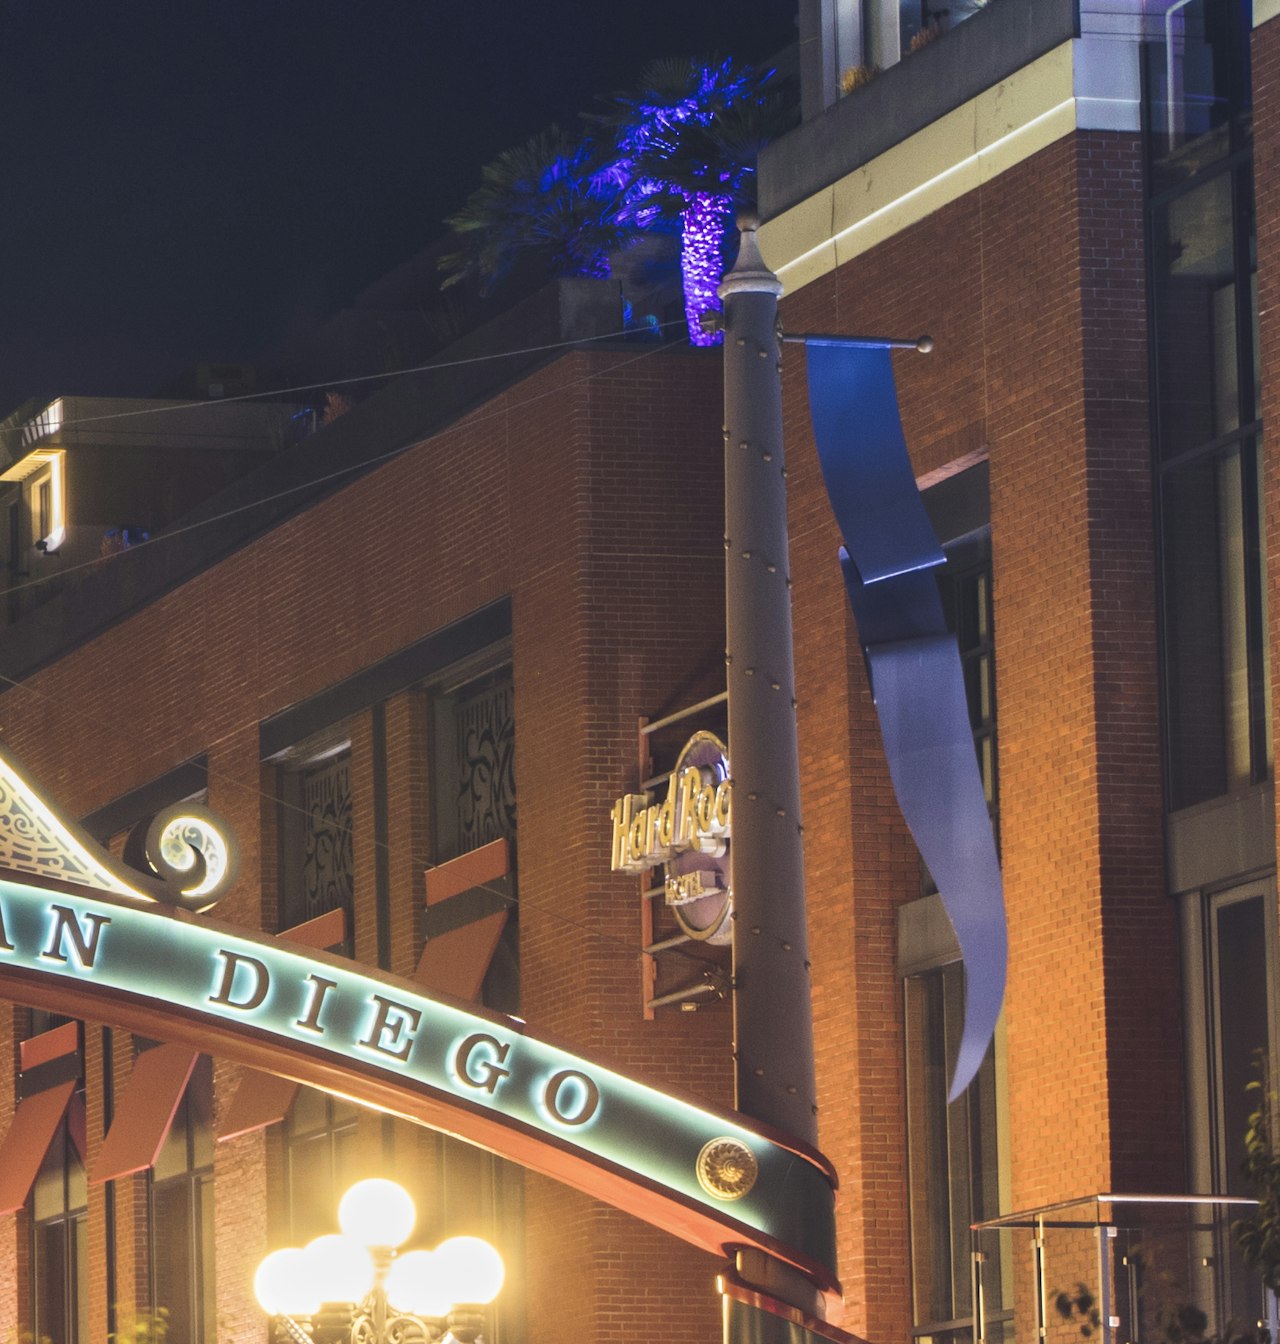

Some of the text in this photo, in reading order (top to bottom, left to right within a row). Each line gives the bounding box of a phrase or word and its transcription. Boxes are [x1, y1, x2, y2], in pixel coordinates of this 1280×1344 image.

[611, 765, 732, 871] Hard Roc
[209, 948, 600, 1127] DIEGO
